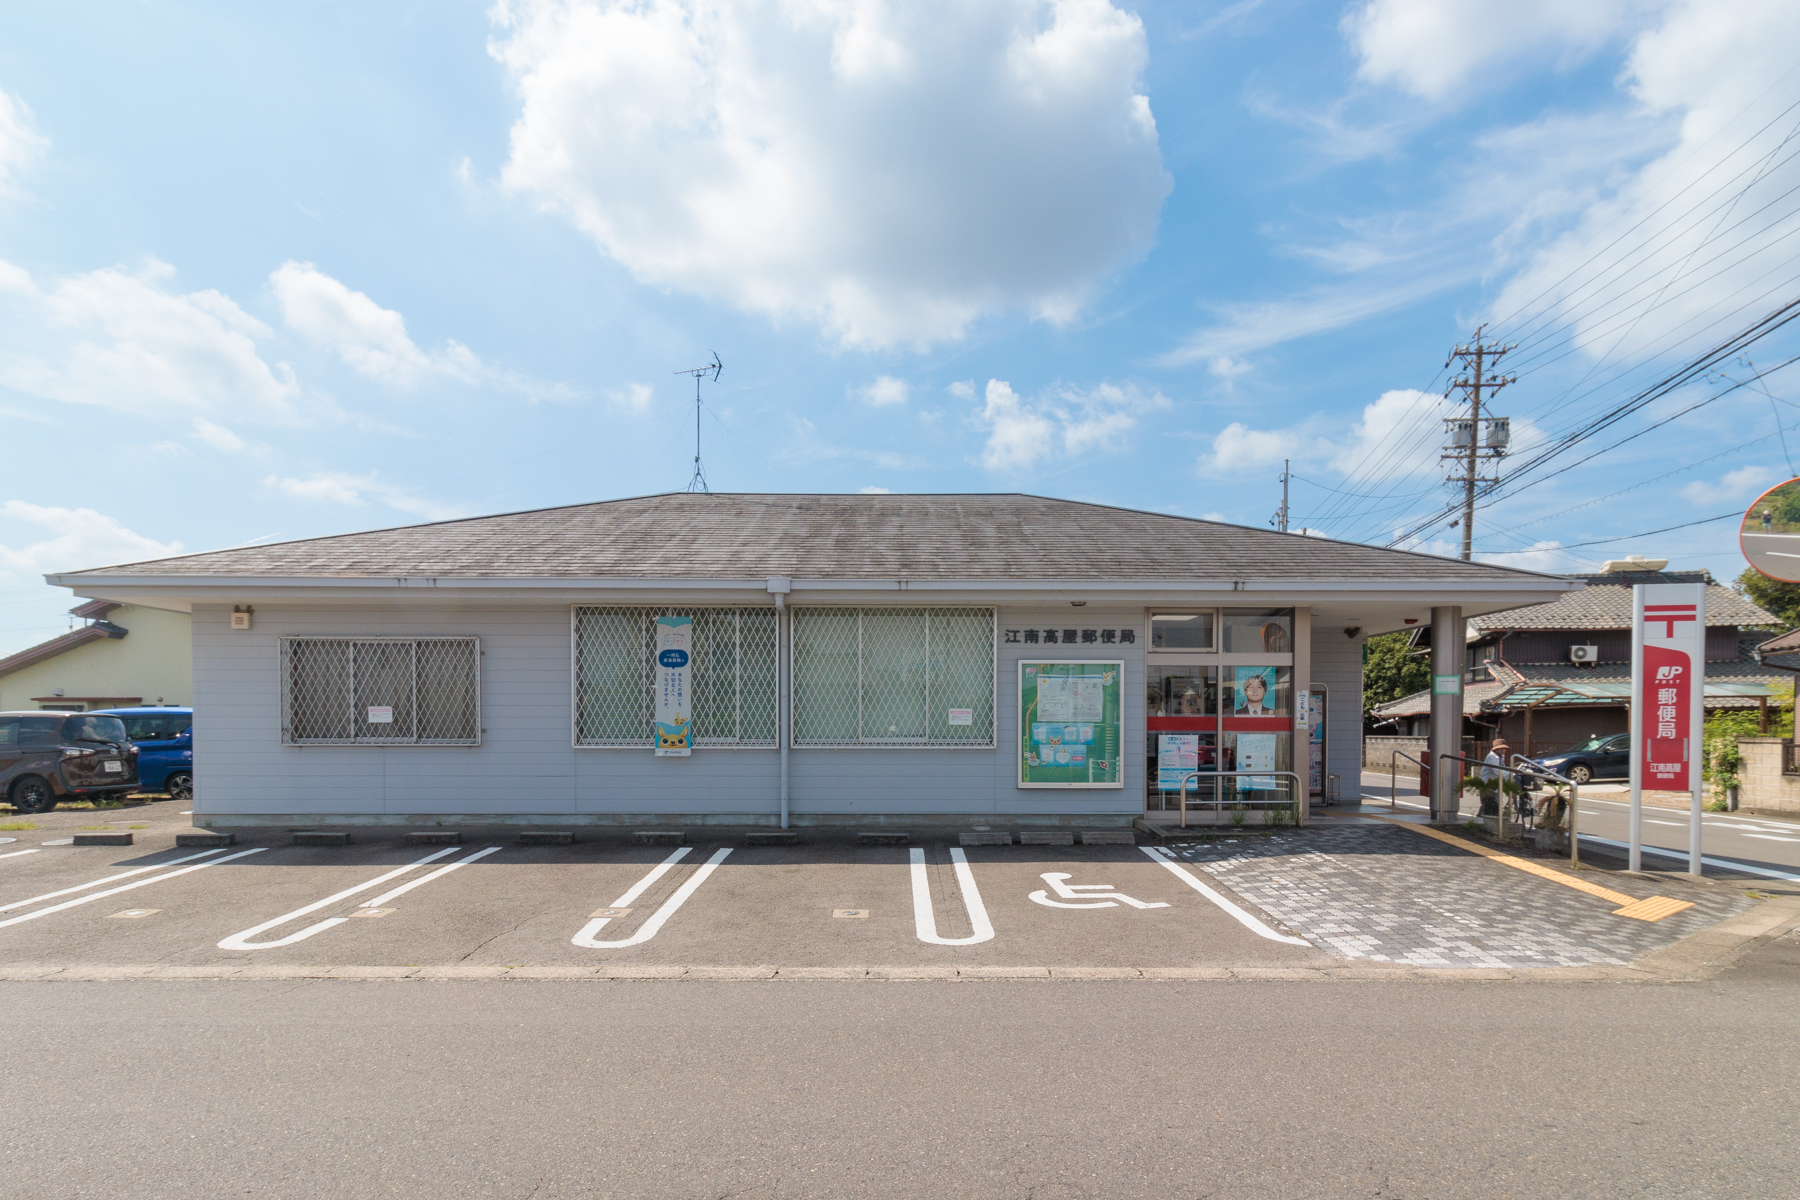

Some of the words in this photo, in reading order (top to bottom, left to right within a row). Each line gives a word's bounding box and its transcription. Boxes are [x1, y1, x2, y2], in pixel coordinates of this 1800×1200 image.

[1005, 628, 1135, 645] 江南高屋郵便局
[1657, 687, 1677, 740] 郵便局
[1649, 762, 1682, 773] 江南高屋
